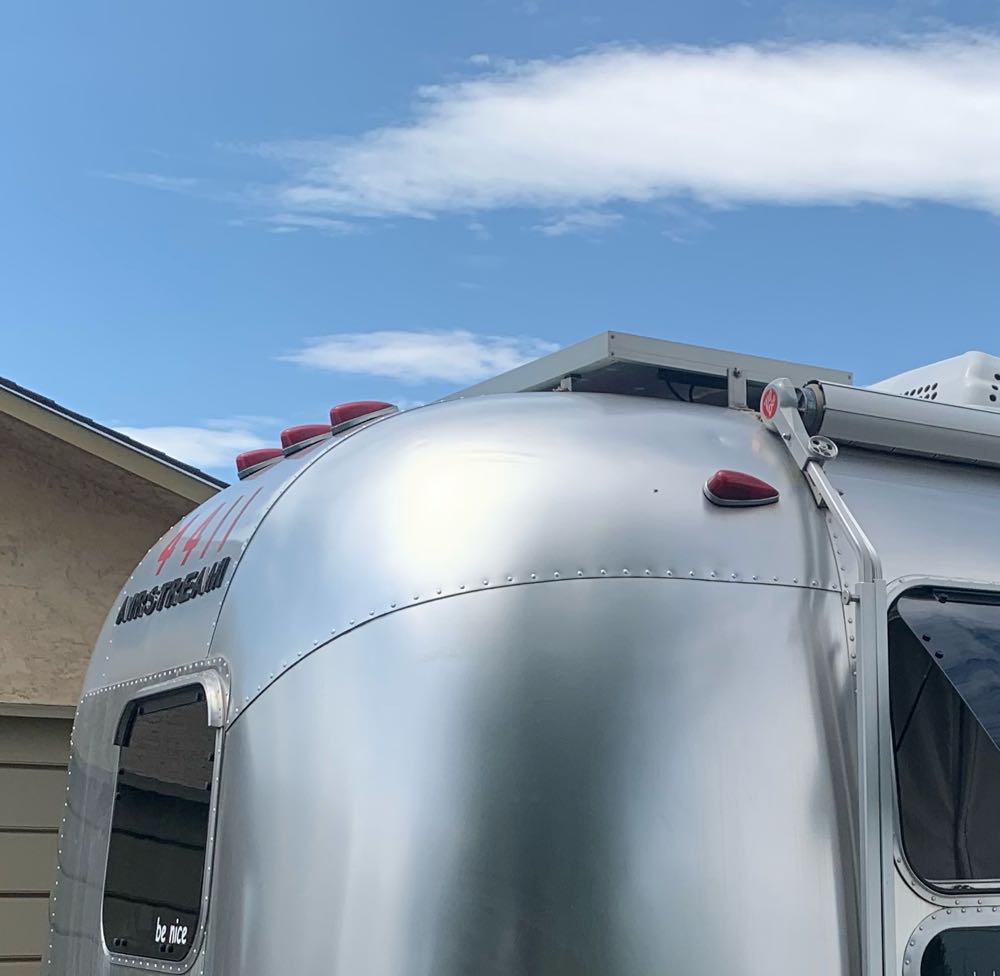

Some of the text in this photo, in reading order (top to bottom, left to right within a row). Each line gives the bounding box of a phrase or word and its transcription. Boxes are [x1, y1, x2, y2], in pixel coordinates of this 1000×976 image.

[155, 486, 264, 576] 4411
[115, 556, 231, 625] AIRSTREAM
[155, 916, 188, 945] be nice
